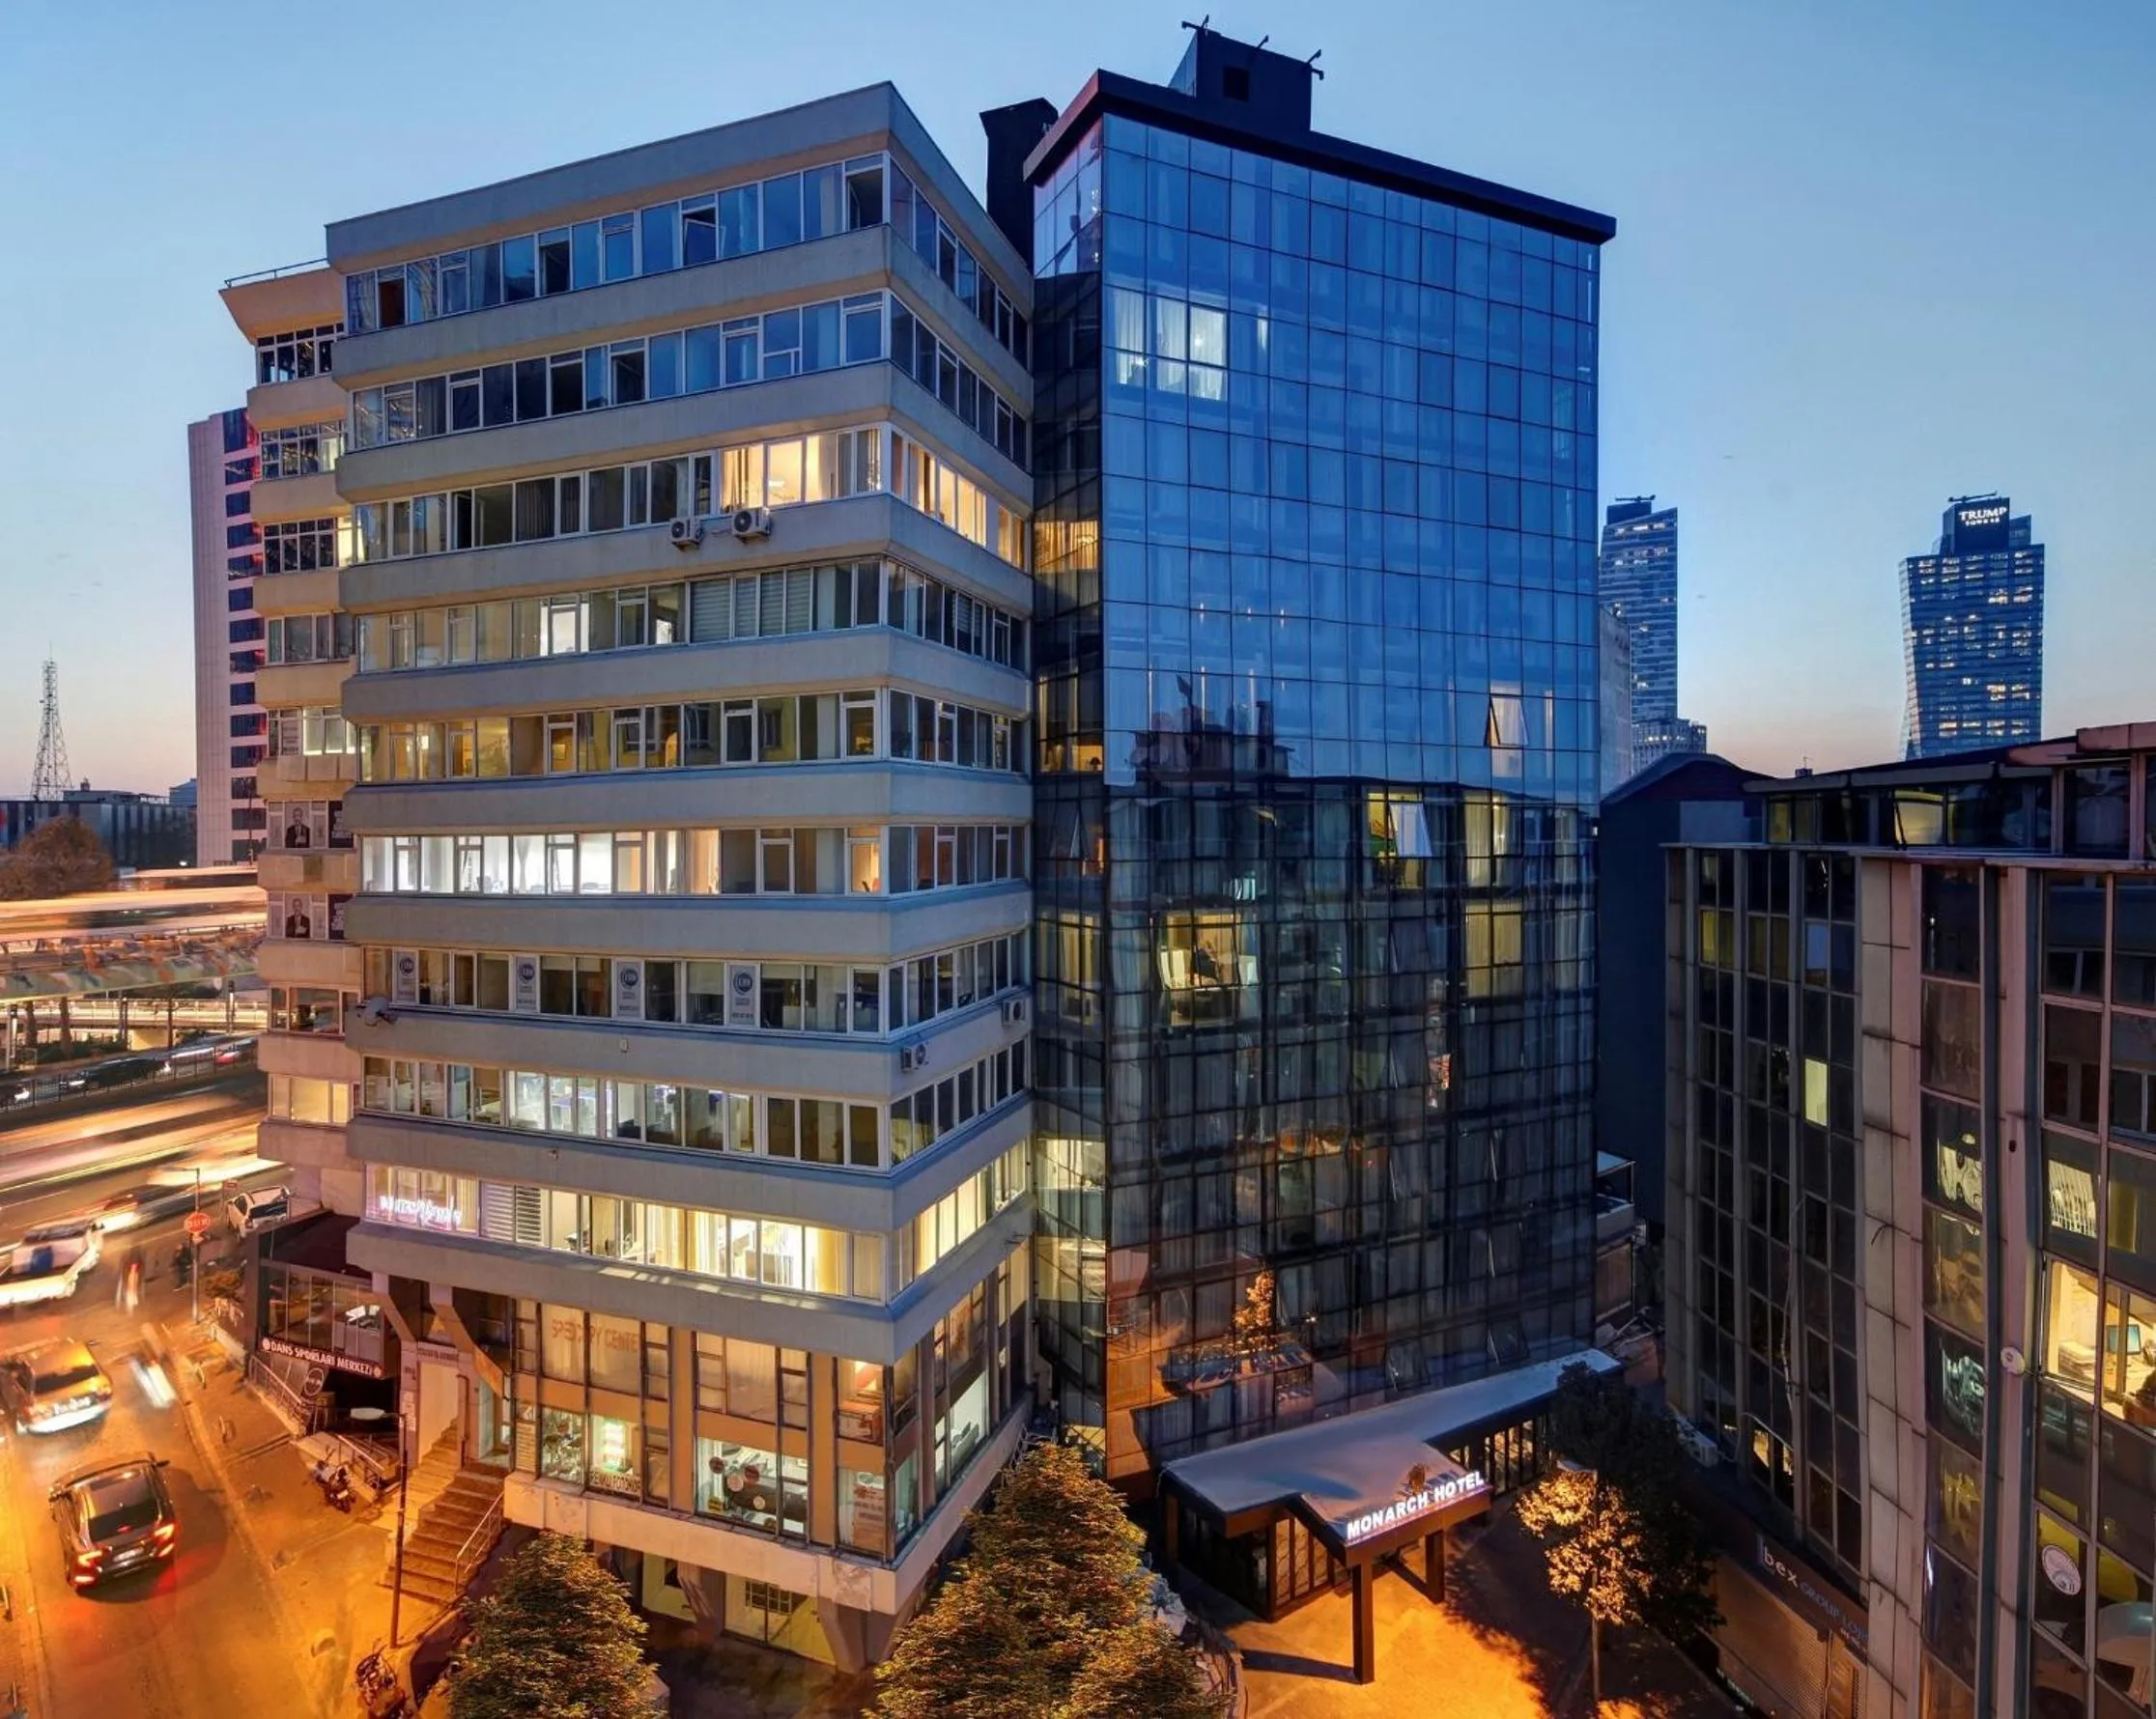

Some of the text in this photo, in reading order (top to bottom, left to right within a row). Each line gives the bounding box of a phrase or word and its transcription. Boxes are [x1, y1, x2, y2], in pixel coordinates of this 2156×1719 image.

[1959, 507, 2007, 521] TRUMP
[270, 1340, 293, 1355] DANS
[1347, 1471, 1485, 1539] MONARCH HOTEL
